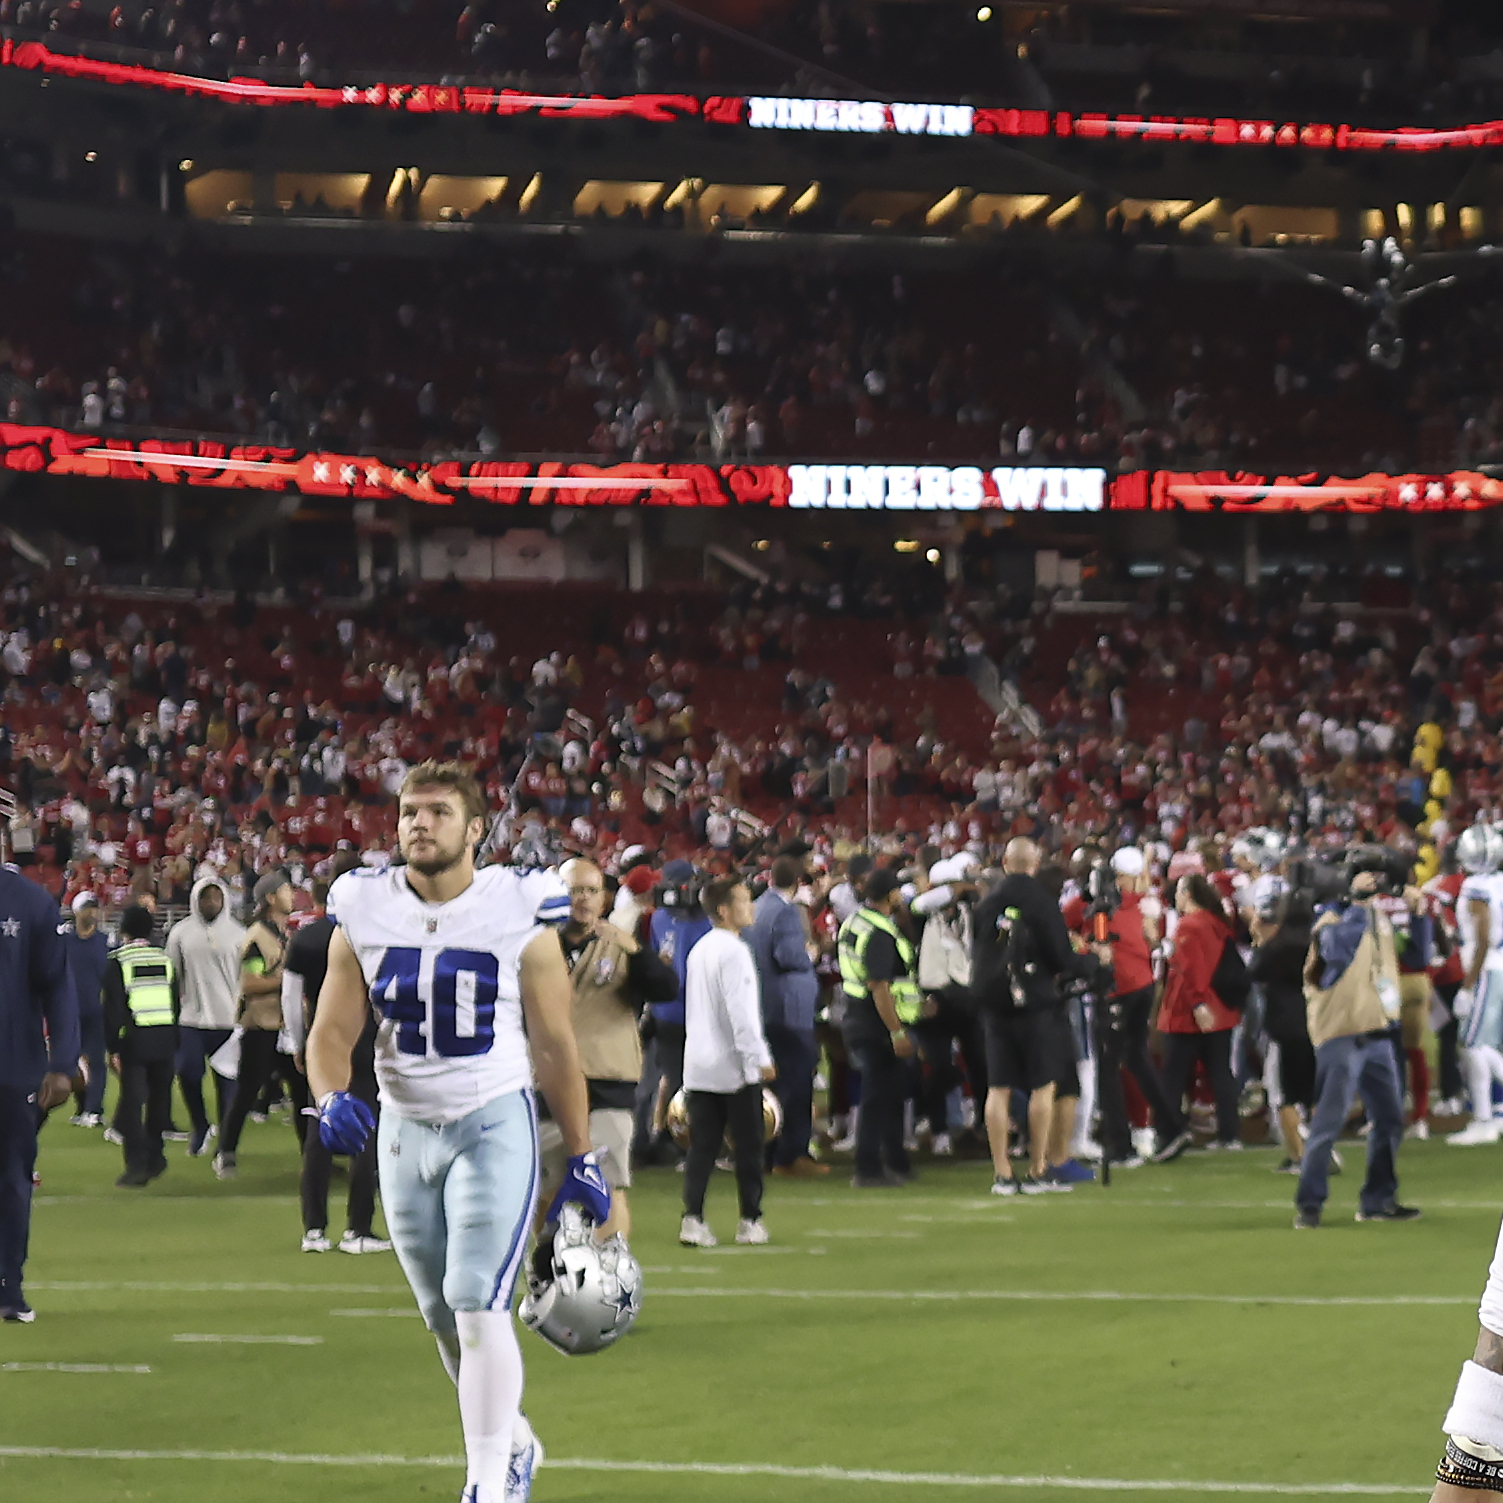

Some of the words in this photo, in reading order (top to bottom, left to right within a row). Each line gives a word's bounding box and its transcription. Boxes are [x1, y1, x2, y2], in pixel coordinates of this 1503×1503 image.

[749, 97, 885, 132] NINERS
[891, 103, 974, 136] WIN
[788, 464, 985, 510] NINERS
[992, 467, 1107, 511] WIN
[371, 946, 500, 1058] 40
[1478, 1462, 1486, 1473] A
[1485, 1465, 1498, 1477] BE
